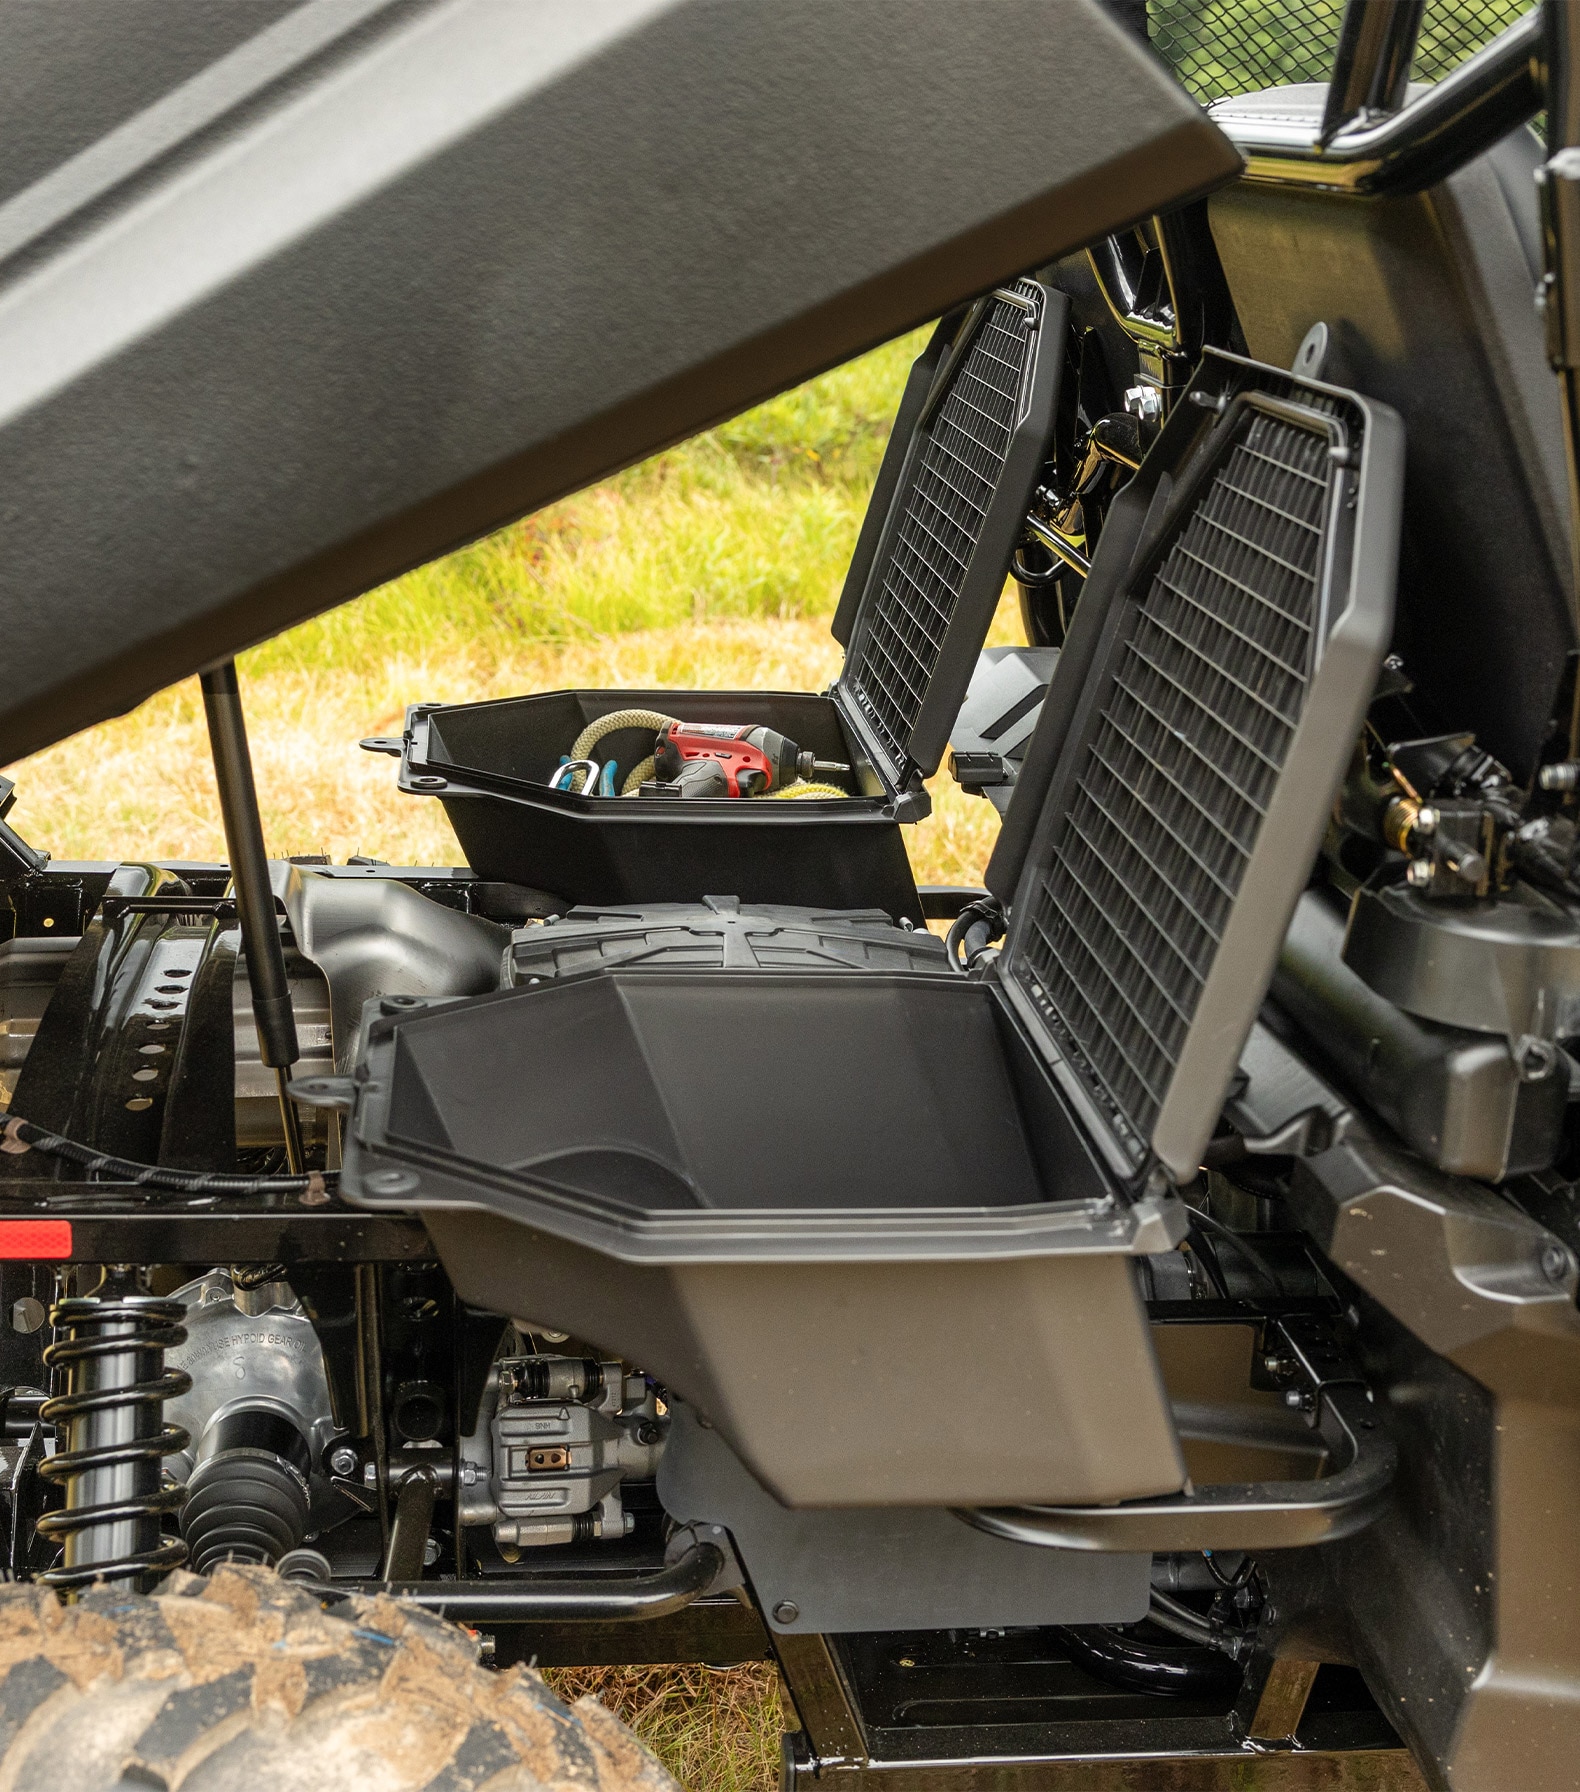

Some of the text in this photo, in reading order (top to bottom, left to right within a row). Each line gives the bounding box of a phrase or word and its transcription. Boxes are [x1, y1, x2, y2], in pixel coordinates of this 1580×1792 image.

[231, 1333, 265, 1346] HYPOID
[268, 1333, 292, 1347] GEAR
[292, 1339, 306, 1353] OIL
